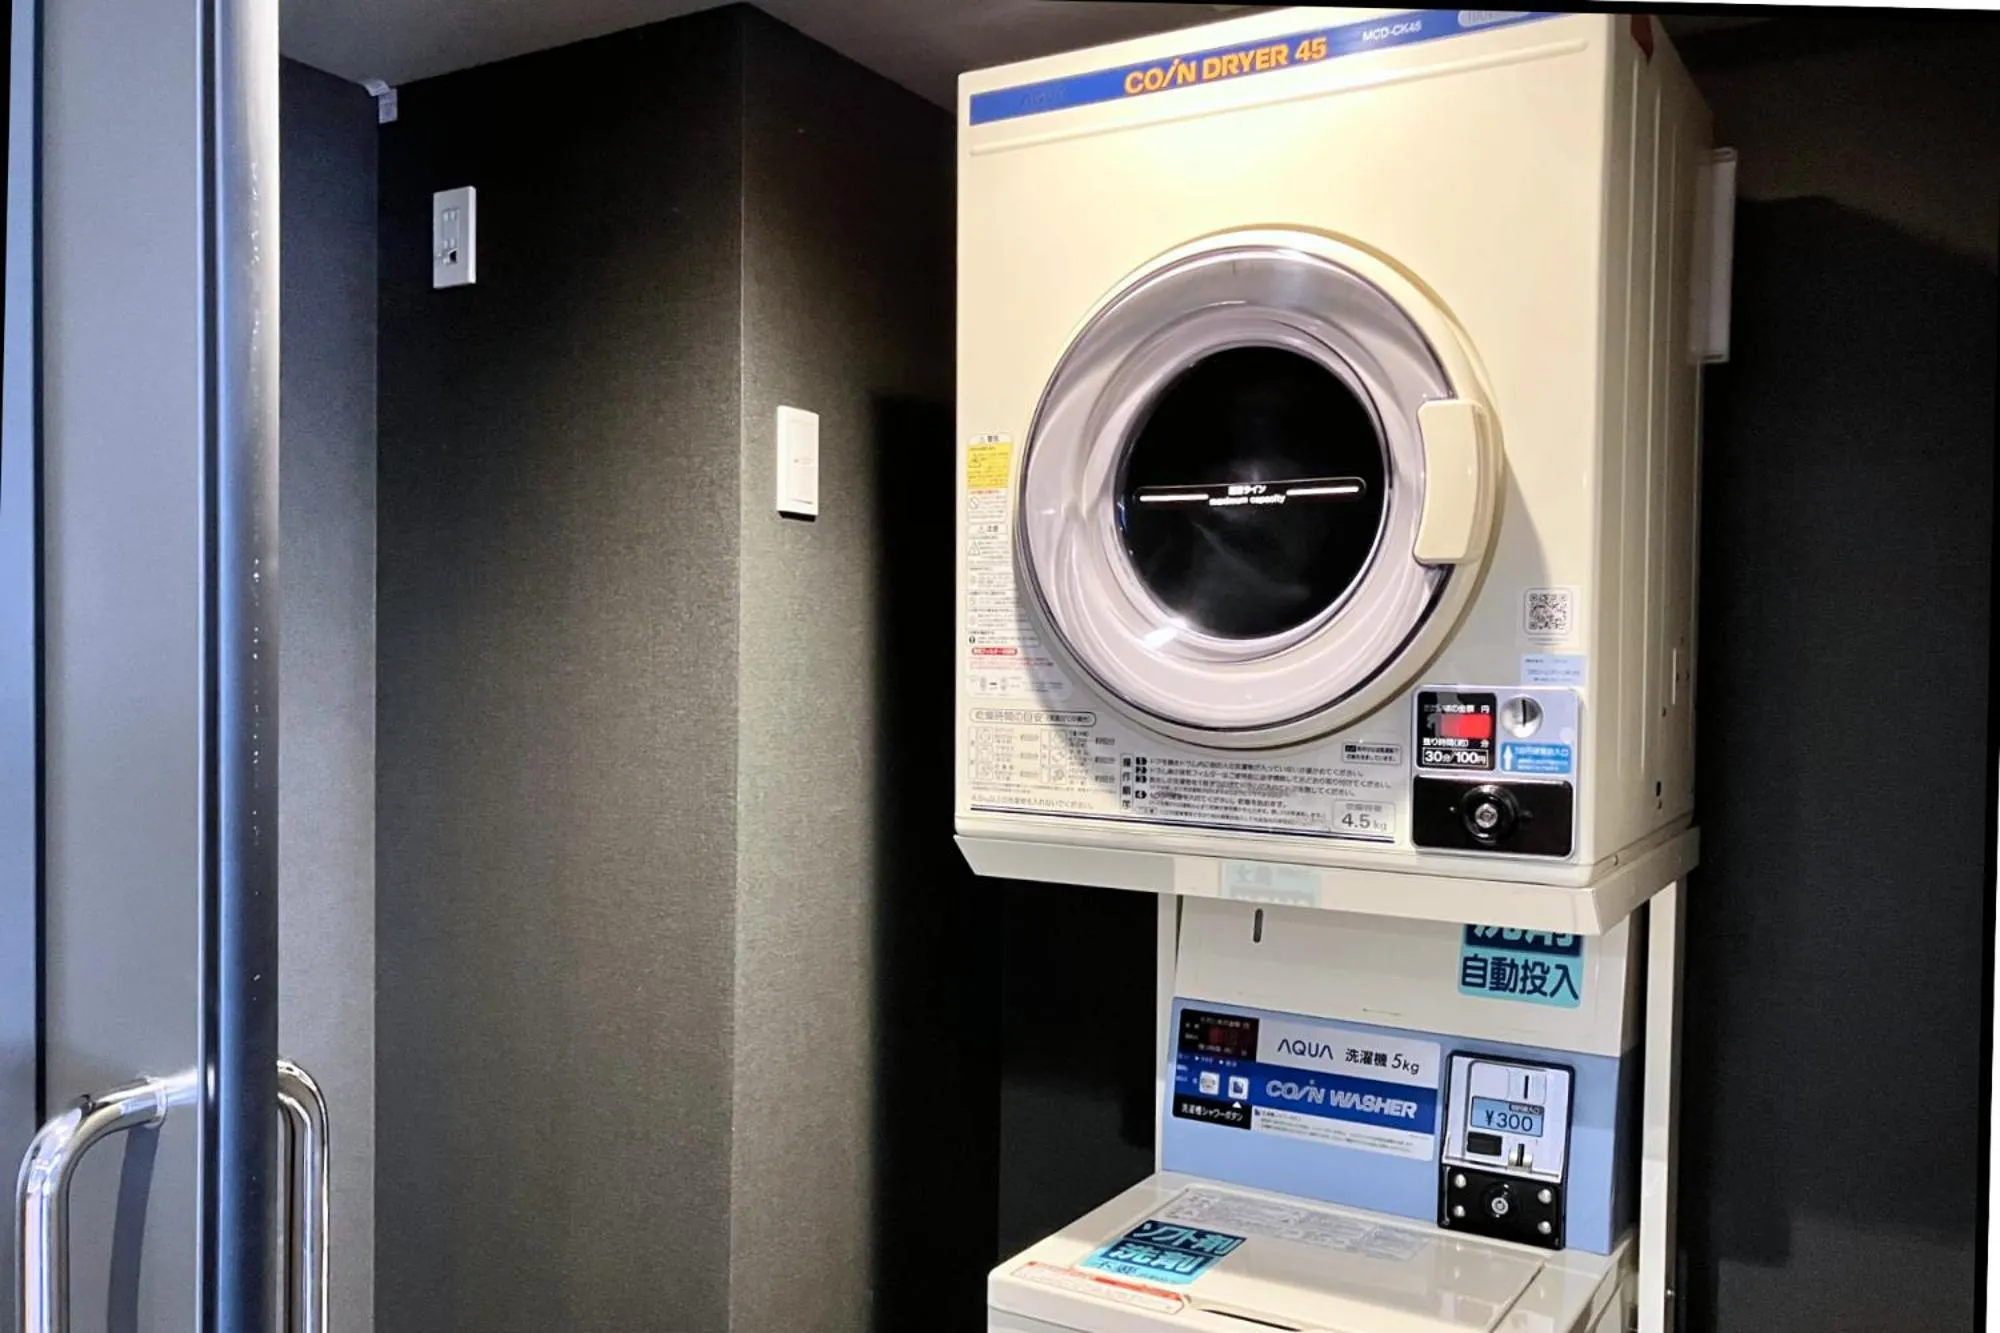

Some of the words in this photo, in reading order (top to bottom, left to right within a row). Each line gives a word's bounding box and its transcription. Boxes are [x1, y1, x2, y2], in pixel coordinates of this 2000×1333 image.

[1124, 56, 1197, 94] COIN
[1202, 44, 1289, 80] DRYER
[1295, 36, 1327, 62] 45
[1341, 813, 1371, 829] 4.5
[1461, 953, 1579, 1000] 自動投入
[1277, 1038, 1334, 1061] AQUA
[1345, 1048, 1388, 1068] 洗濯機
[1391, 1053, 1420, 1076] 5kg
[1265, 1079, 1325, 1106] COIN
[1330, 1089, 1419, 1120] WASHER
[1485, 1109, 1534, 1133] ¥300
[1132, 1222, 1244, 1256] ソフト剤
[1109, 1242, 1204, 1274] 洗剤
